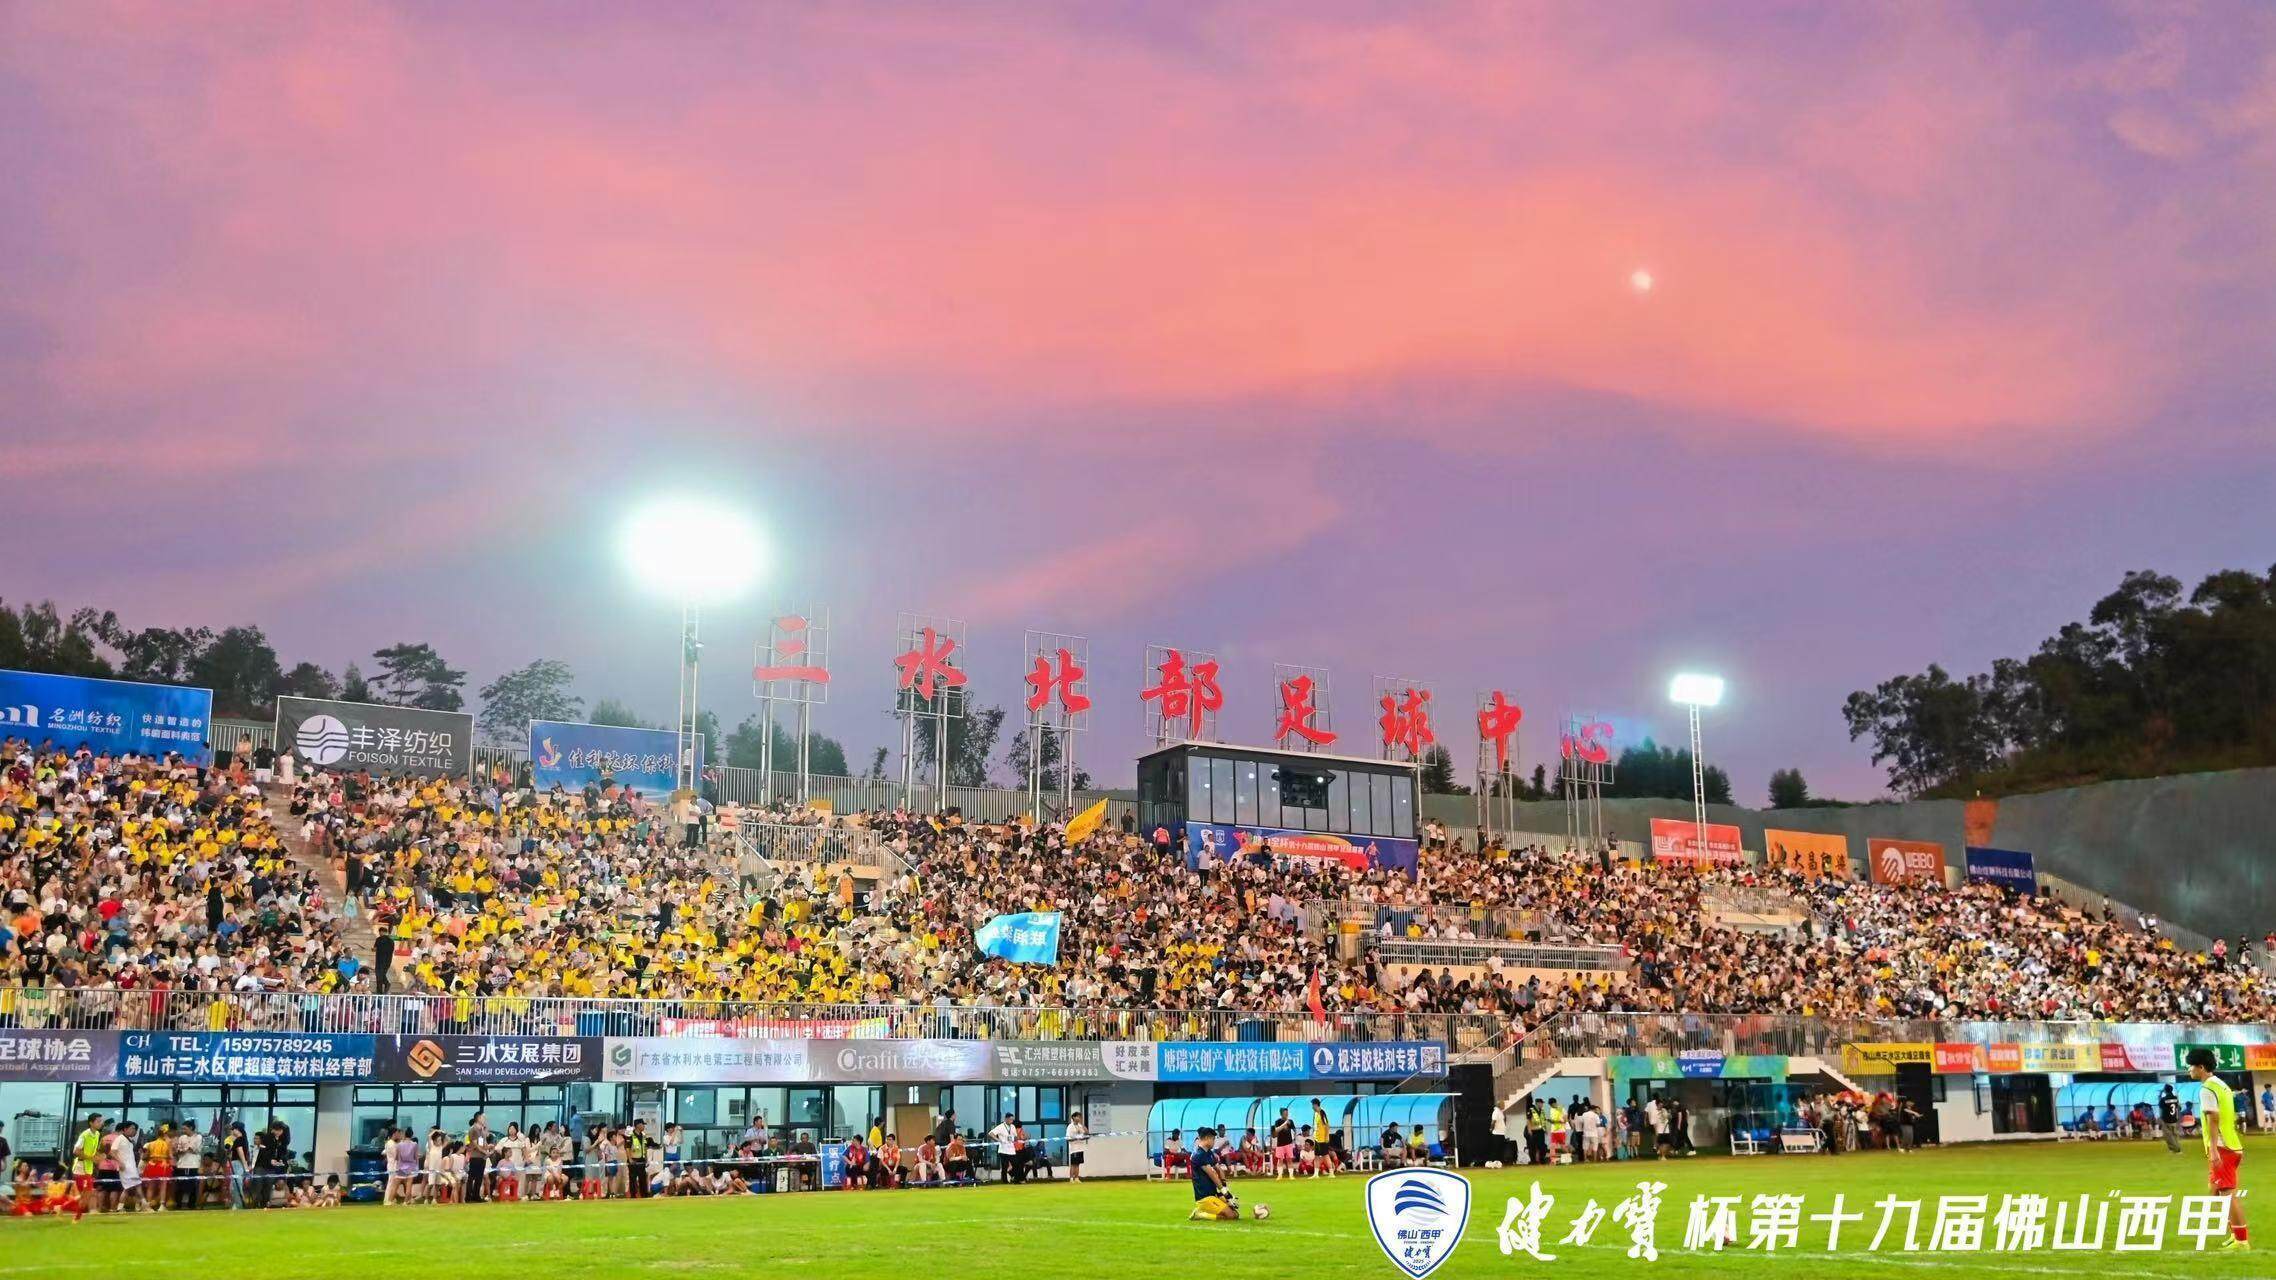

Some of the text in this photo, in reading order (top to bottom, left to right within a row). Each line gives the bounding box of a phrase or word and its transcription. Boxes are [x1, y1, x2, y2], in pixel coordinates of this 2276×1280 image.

[49, 707, 122, 727] 名洲纺织
[91, 727, 120, 735] TEXTILE
[351, 725, 453, 756] 丰泽纺织
[348, 751, 453, 769] FOISON TEXTILE
[0, 1038, 92, 1061] 足球协会
[222, 1038, 332, 1053] 15975789245
[456, 1043, 581, 1064] 三水发展集团
[640, 1052, 802, 1067] 广东省水利水电第三工程局有限公司
[1024, 1046, 1100, 1061] 汇兴隆塑料有限公司
[125, 1055, 372, 1077] 佛山市三水区肥超建筑材料经营部
[456, 1067, 581, 1076] SAN SHUI DEVELOPMENT GROUP
[1115, 1060, 1150, 1072] 汇兴隆
[2169, 1103, 2176, 1116] 3
